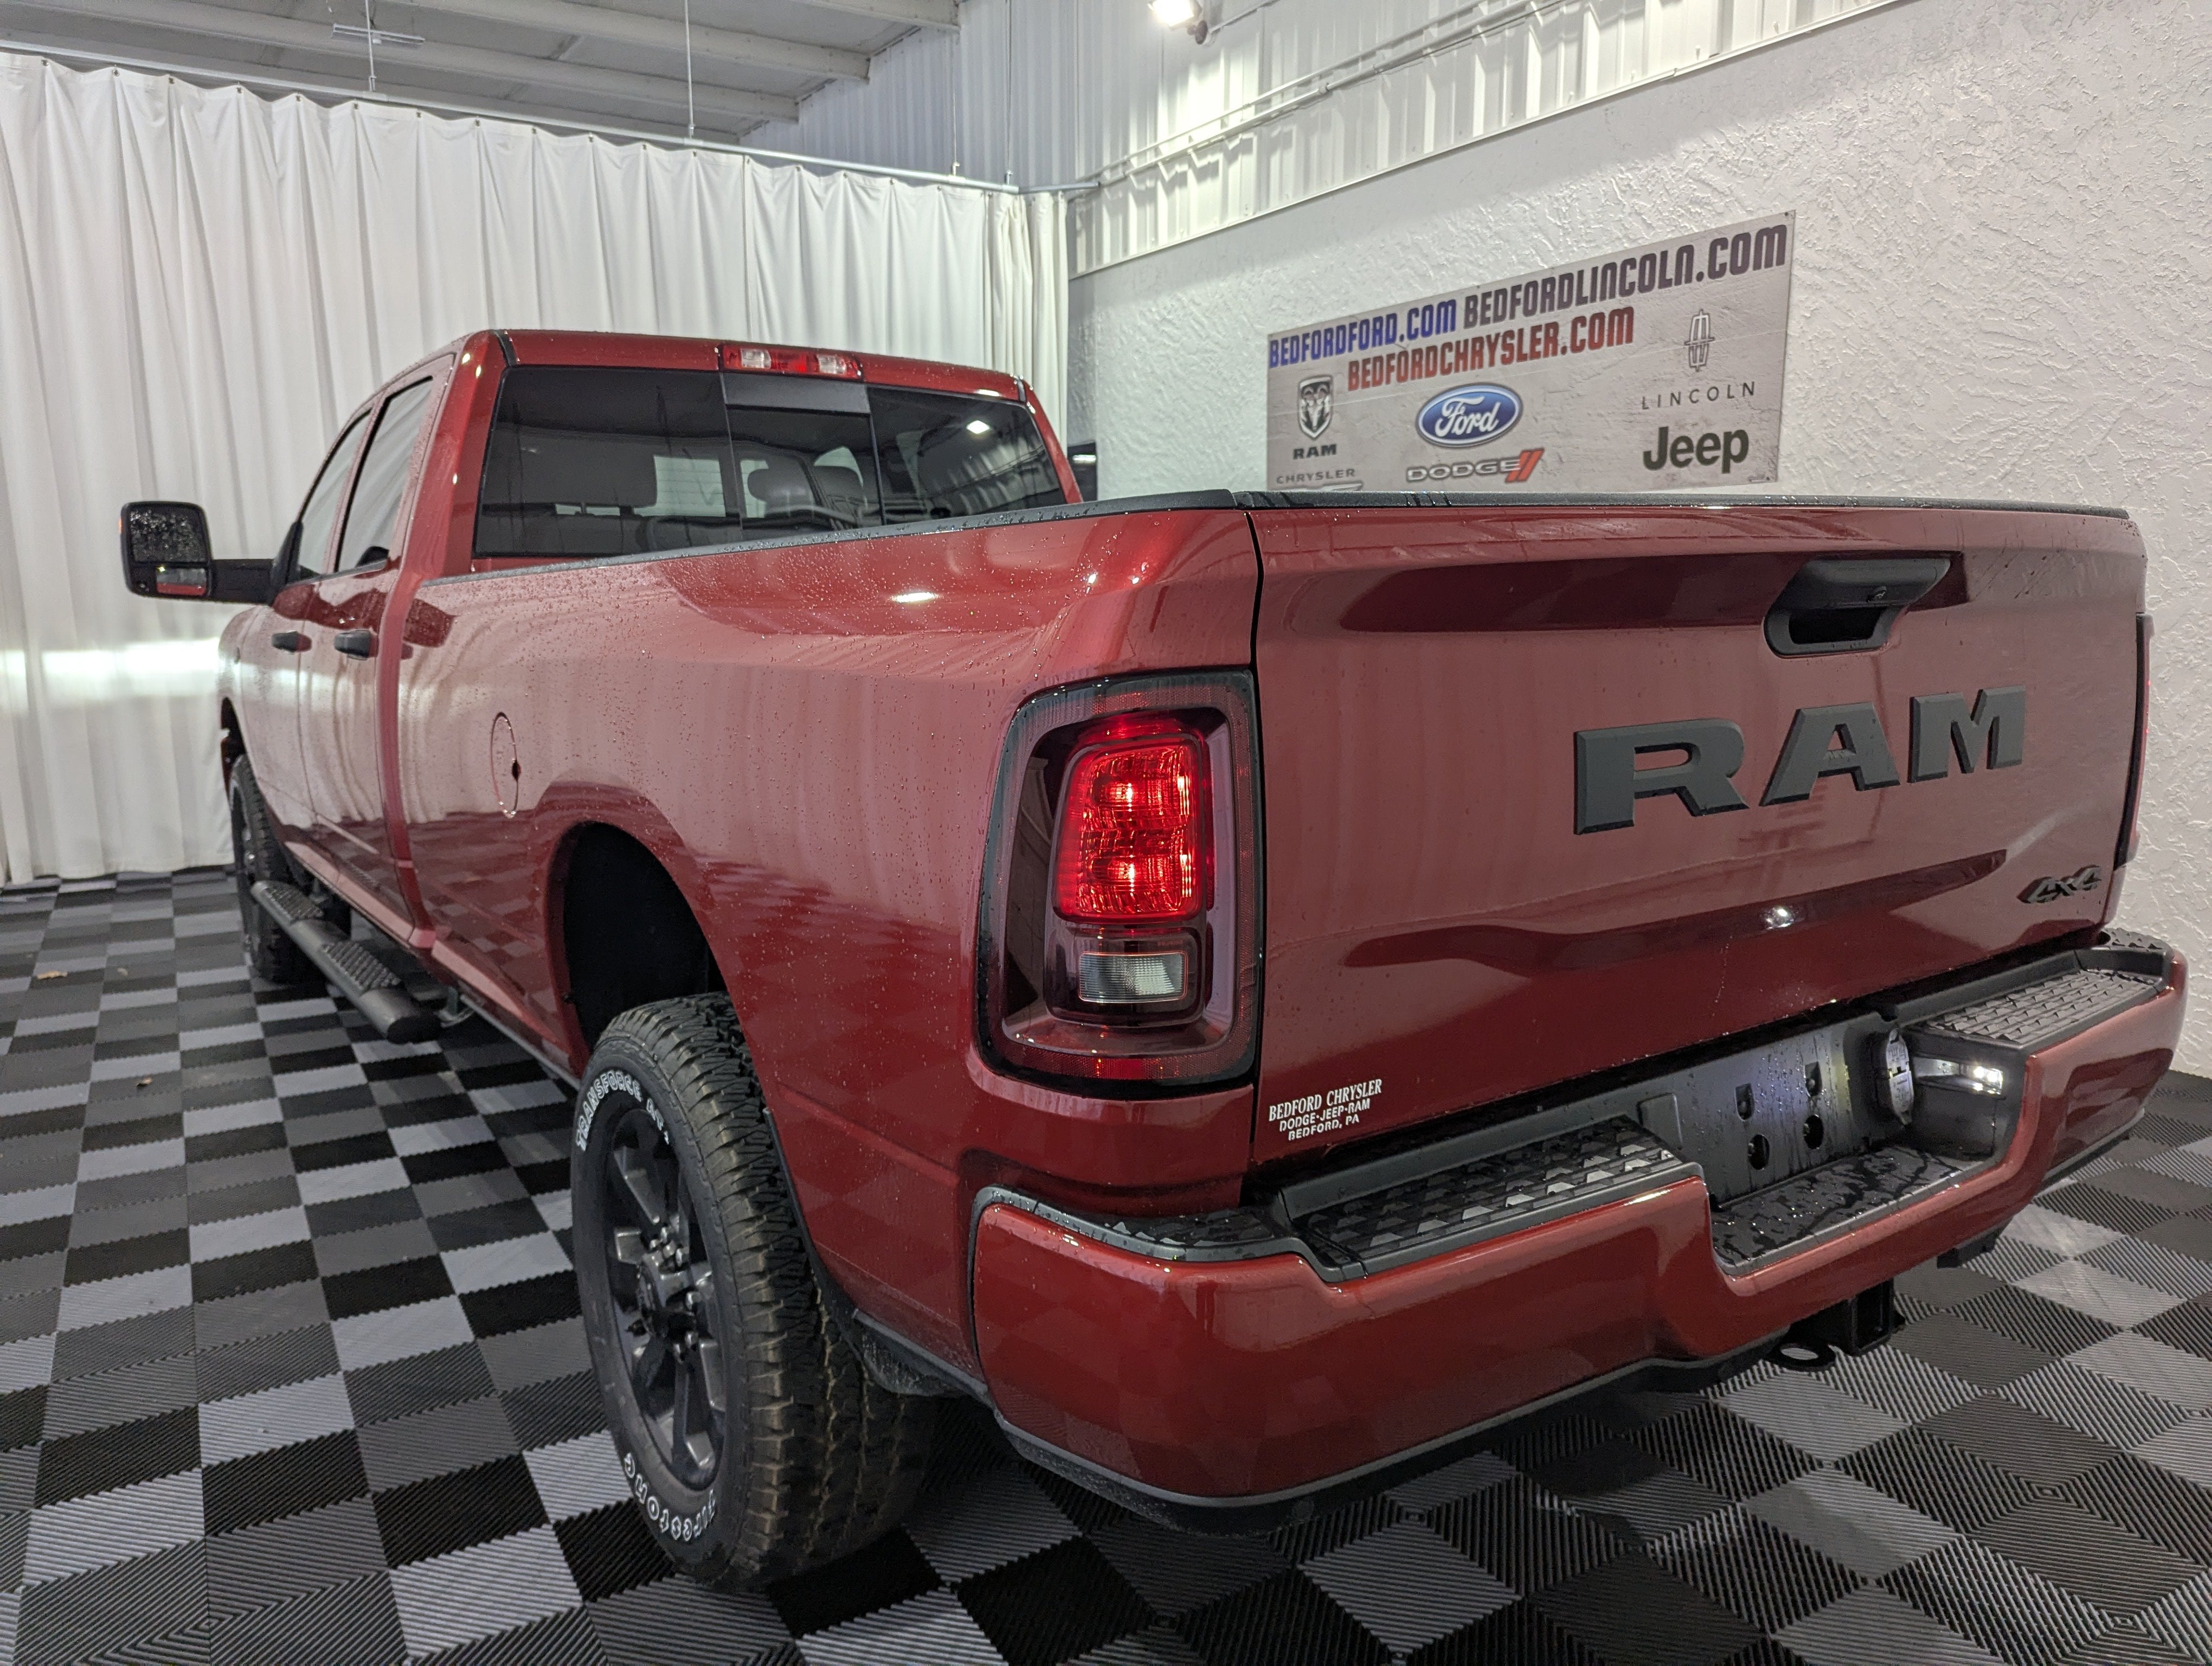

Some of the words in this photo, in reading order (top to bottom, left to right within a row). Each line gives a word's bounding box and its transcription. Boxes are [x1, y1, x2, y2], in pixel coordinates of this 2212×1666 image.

[1269, 299, 1457, 368] BEDFORDFORD.COM
[1464, 224, 1787, 329] BEDFORDLINCOLN.COM
[1348, 306, 1634, 391] BEDFORDCHRYSLER.COM
[1435, 395, 1500, 437] Ford
[1642, 381, 1754, 409] LINCOLN
[1293, 444, 1338, 460] RAM
[1406, 456, 1521, 483] DODGE
[1643, 426, 1749, 474] Jeep
[1276, 468, 1355, 484] CHRYSLER
[1574, 684, 2026, 836] RAM
[1268, 1094, 1322, 1122] BEDFORD
[1326, 1079, 1382, 1106] CHRYSLER
[1288, 1119, 1342, 1140] BEDFORD,
[1345, 1114, 1360, 1126] PA
